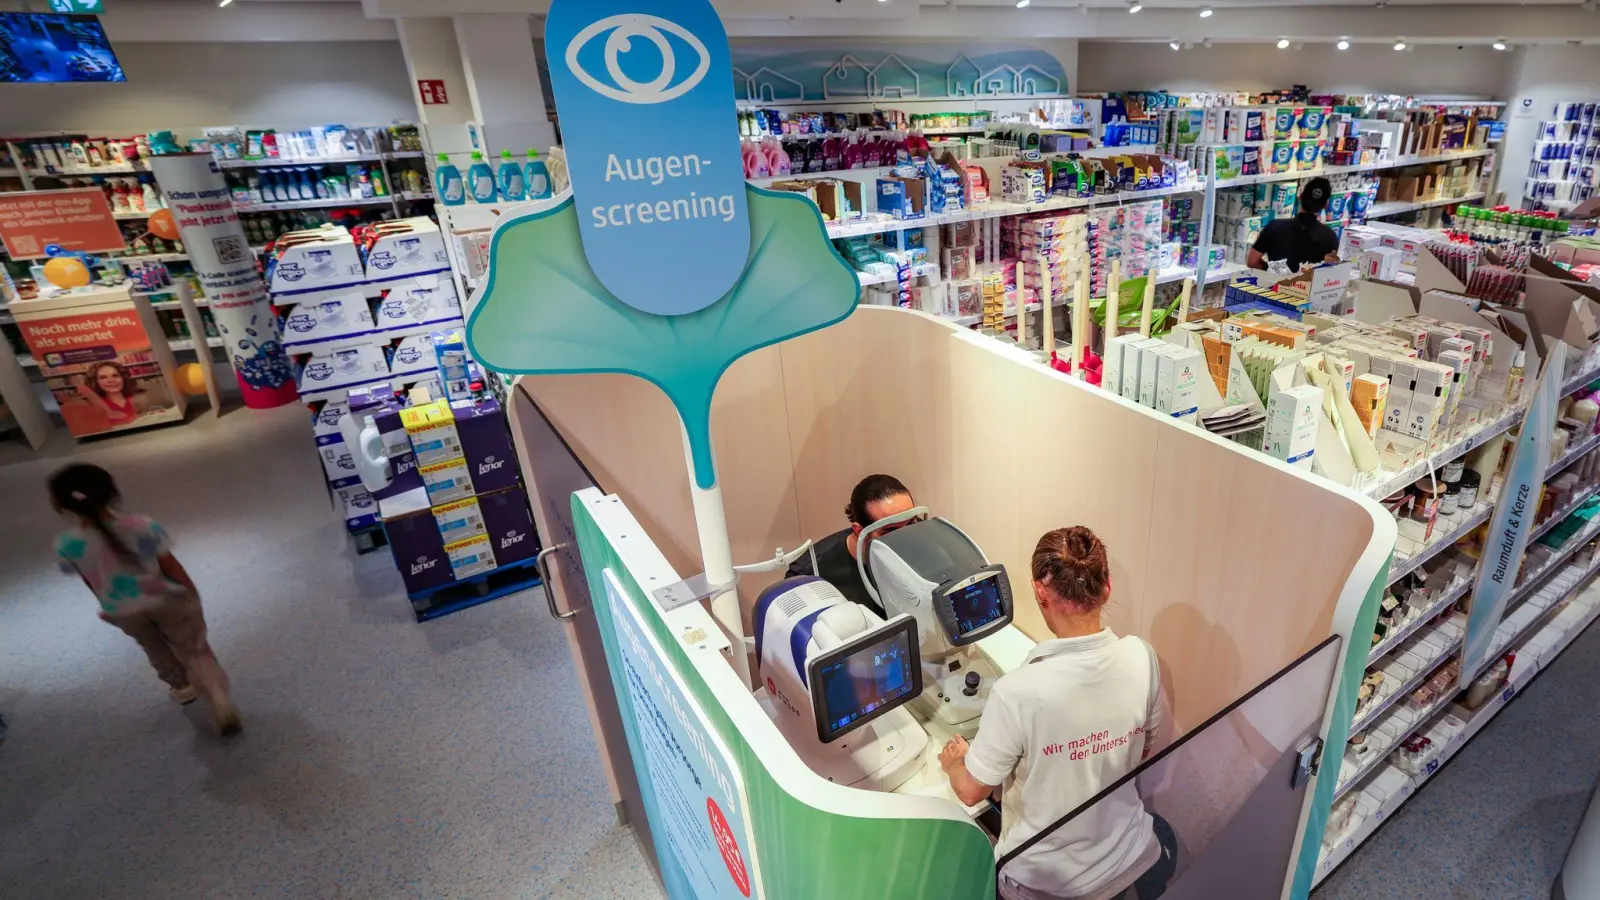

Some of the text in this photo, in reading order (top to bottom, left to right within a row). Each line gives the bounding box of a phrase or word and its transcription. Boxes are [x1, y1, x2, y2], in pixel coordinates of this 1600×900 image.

[605, 153, 712, 185] Augen-
[592, 191, 735, 228] screening
[201, 215, 226, 227] jetzt
[29, 316, 137, 336] Noch mehr drin,
[36, 330, 115, 348] als erwartet
[478, 460, 504, 475] Lenor
[501, 533, 526, 549] Lenor
[1492, 484, 1530, 583] Raumduft & Kerze
[411, 557, 438, 575] Lenor
[610, 589, 736, 814] Augenscreening
[1043, 730, 1109, 756] Wir machen
[1069, 749, 1090, 760] den
